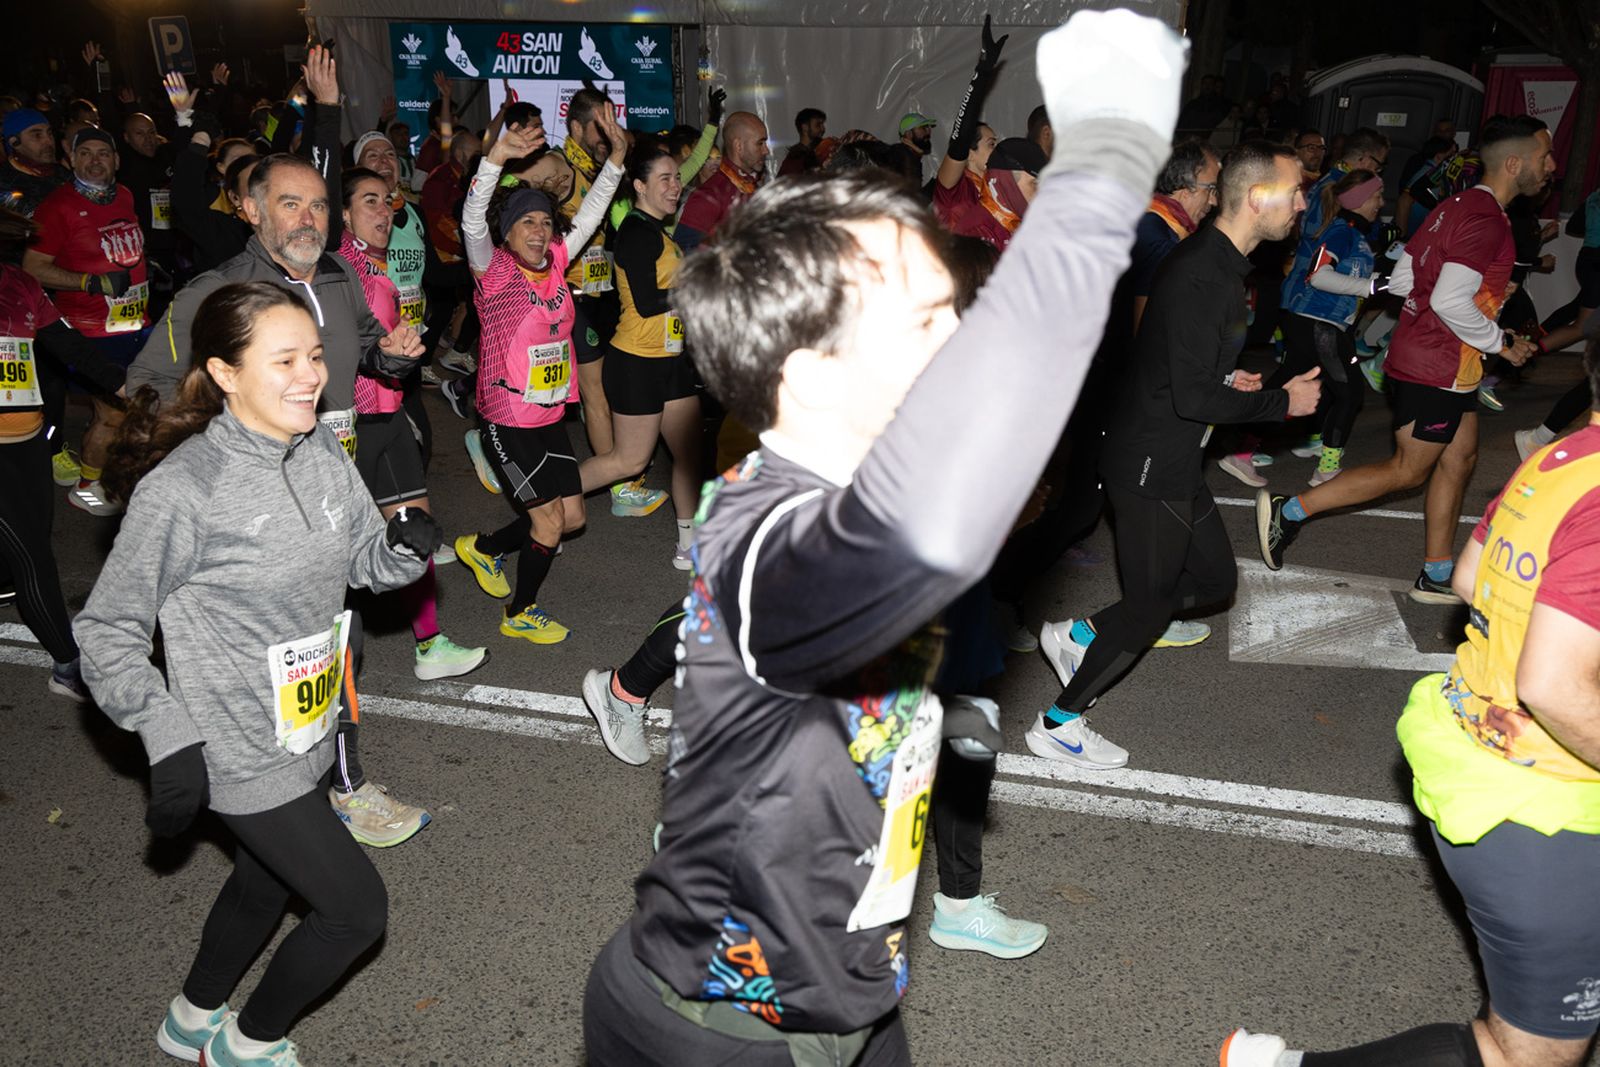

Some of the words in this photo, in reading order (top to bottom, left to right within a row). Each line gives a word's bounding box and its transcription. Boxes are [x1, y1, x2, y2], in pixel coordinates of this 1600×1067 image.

[159, 24, 184, 70] P
[496, 32, 521, 53] 43
[522, 33, 563, 53] SAN
[492, 50, 561, 76] ANTÓN
[628, 105, 670, 116] calderón
[544, 363, 564, 385] 331
[298, 645, 328, 664] NOCHE
[287, 665, 309, 683] SAN
